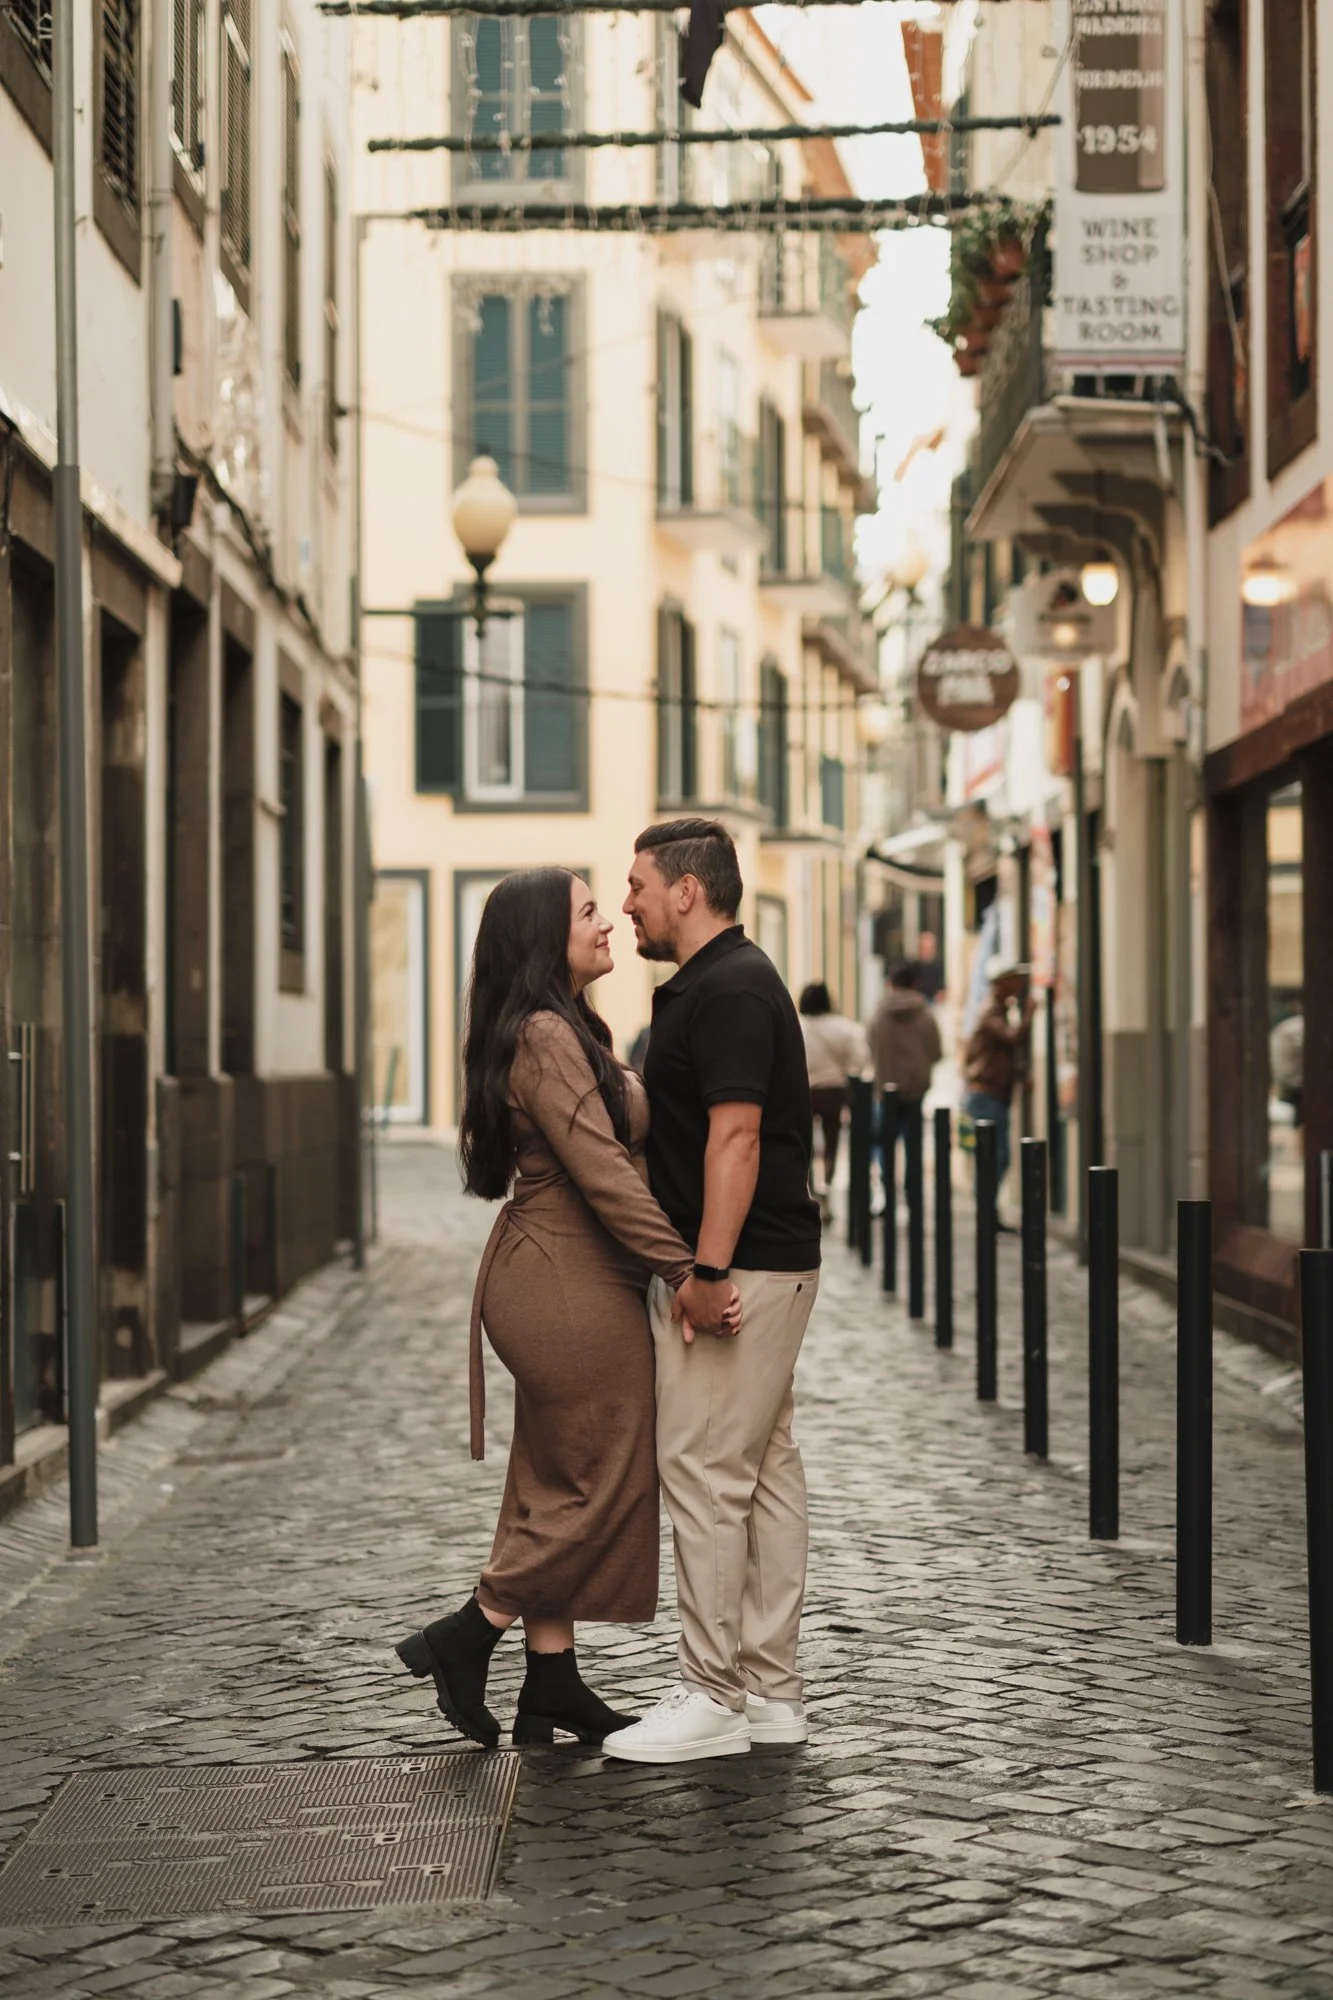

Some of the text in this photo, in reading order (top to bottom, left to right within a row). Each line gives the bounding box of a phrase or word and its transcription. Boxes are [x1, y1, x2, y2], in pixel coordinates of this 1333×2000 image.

[1081, 124, 1157, 154] 1954
[1081, 217, 1158, 239] WINE
[1081, 244, 1158, 265] SHOP
[1111, 271, 1128, 289] &
[1061, 295, 1180, 317] TASTING
[1078, 322, 1162, 342] ROOM
